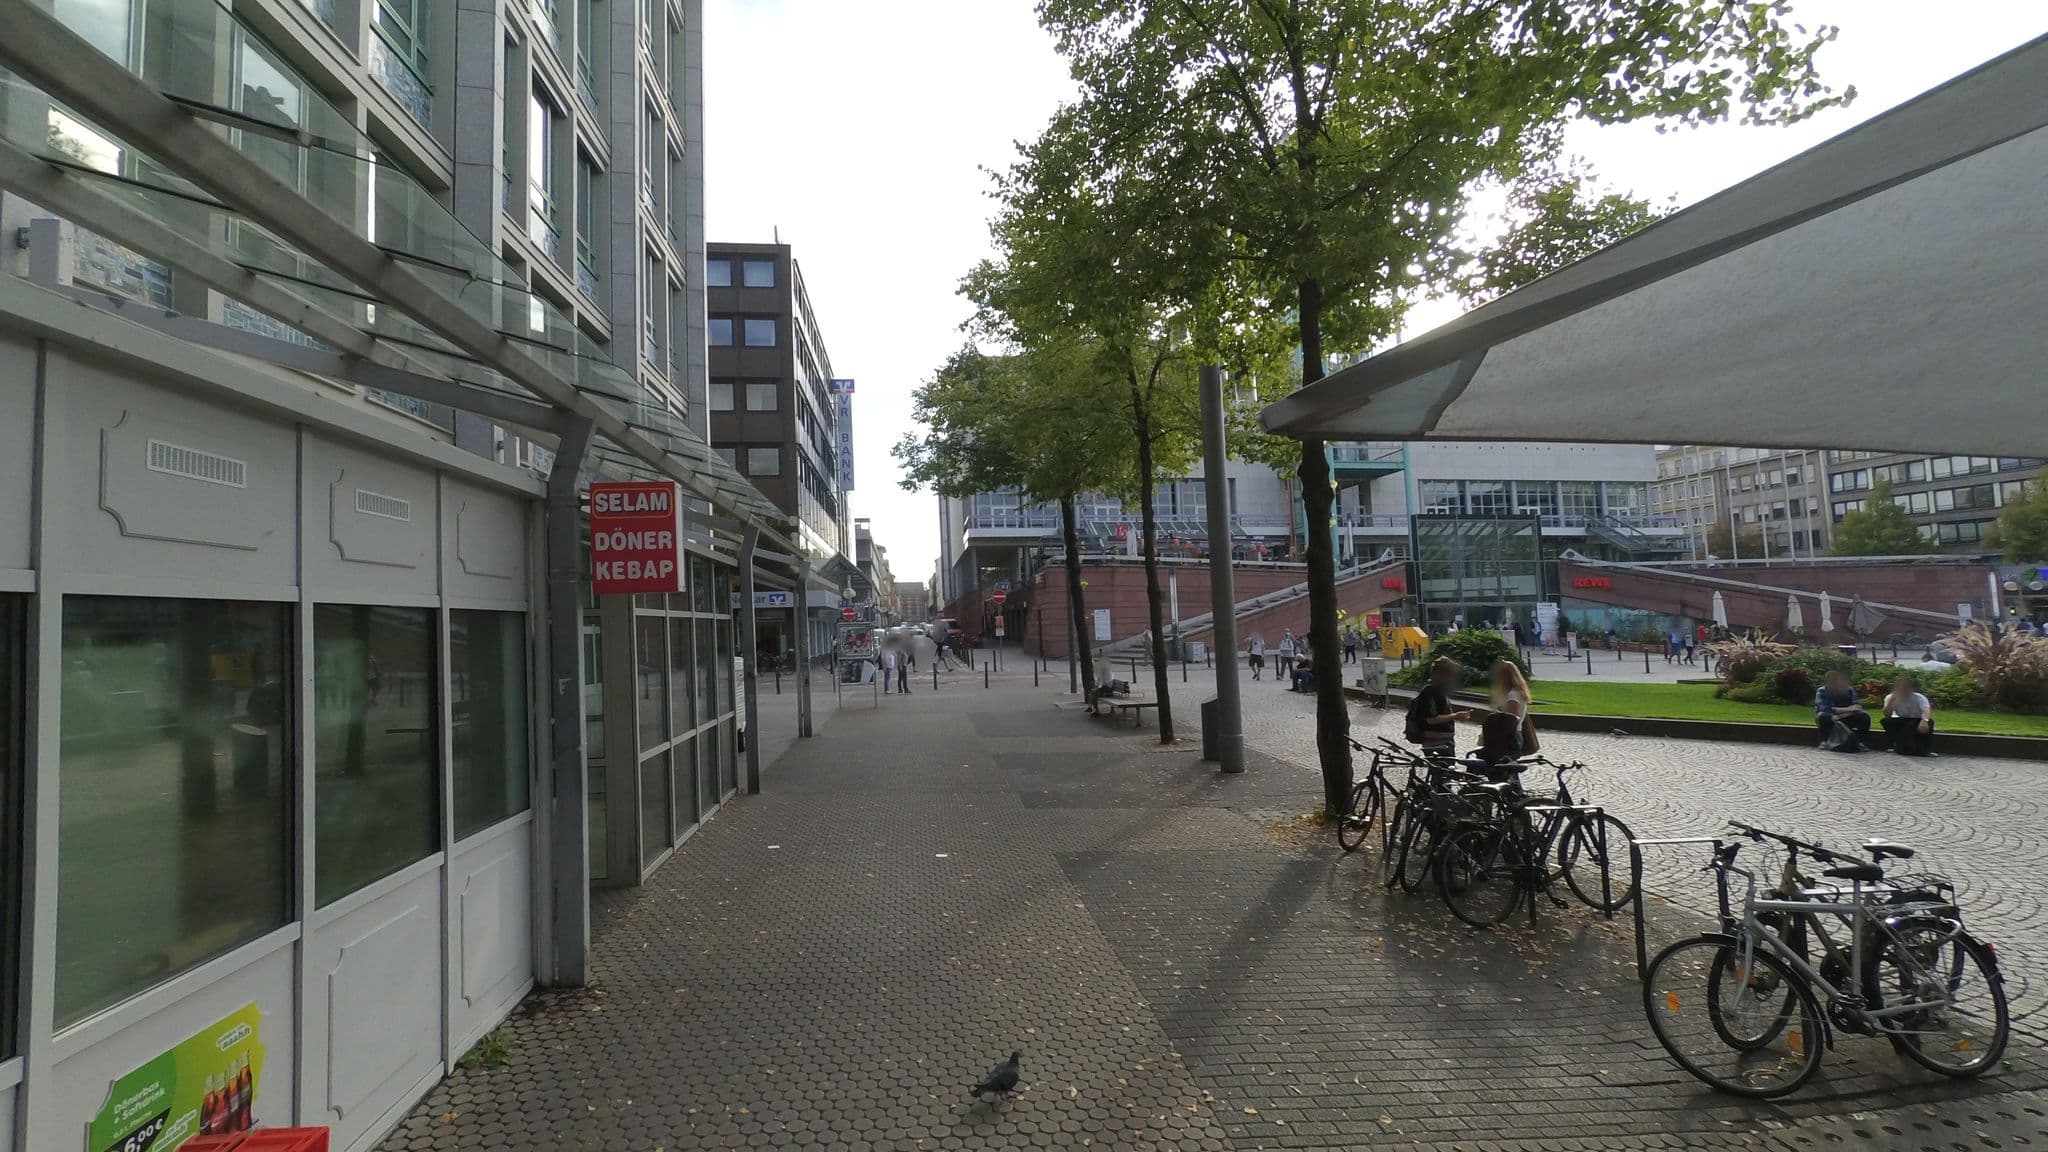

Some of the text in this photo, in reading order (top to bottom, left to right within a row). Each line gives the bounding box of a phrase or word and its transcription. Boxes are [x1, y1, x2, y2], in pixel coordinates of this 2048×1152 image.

[840, 395, 851, 481] VR BANK
[595, 492, 668, 513] SELAM
[595, 527, 672, 551] DÖNER
[596, 560, 674, 580] KEBAP
[114, 1081, 160, 1114] Dönerbox
[122, 1088, 166, 1120] Softdrink
